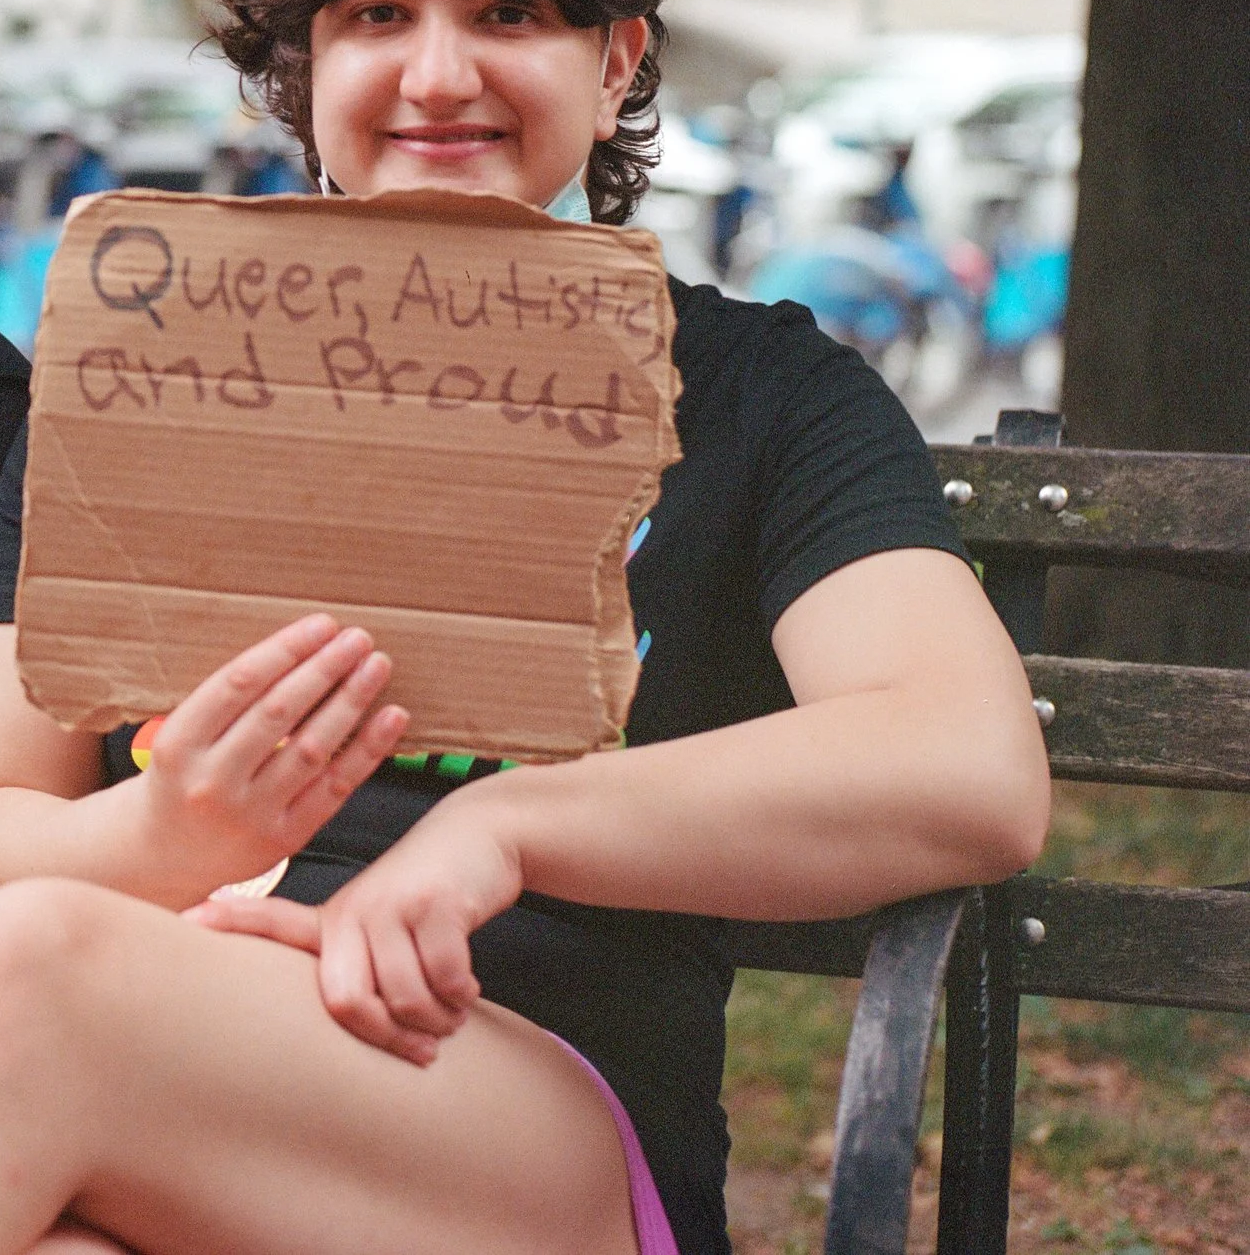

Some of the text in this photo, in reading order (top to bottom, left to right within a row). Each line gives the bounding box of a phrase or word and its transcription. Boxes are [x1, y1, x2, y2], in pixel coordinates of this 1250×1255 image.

[90, 224, 666, 366] Queer, Autistic,
[76, 331, 623, 448] and Proud
